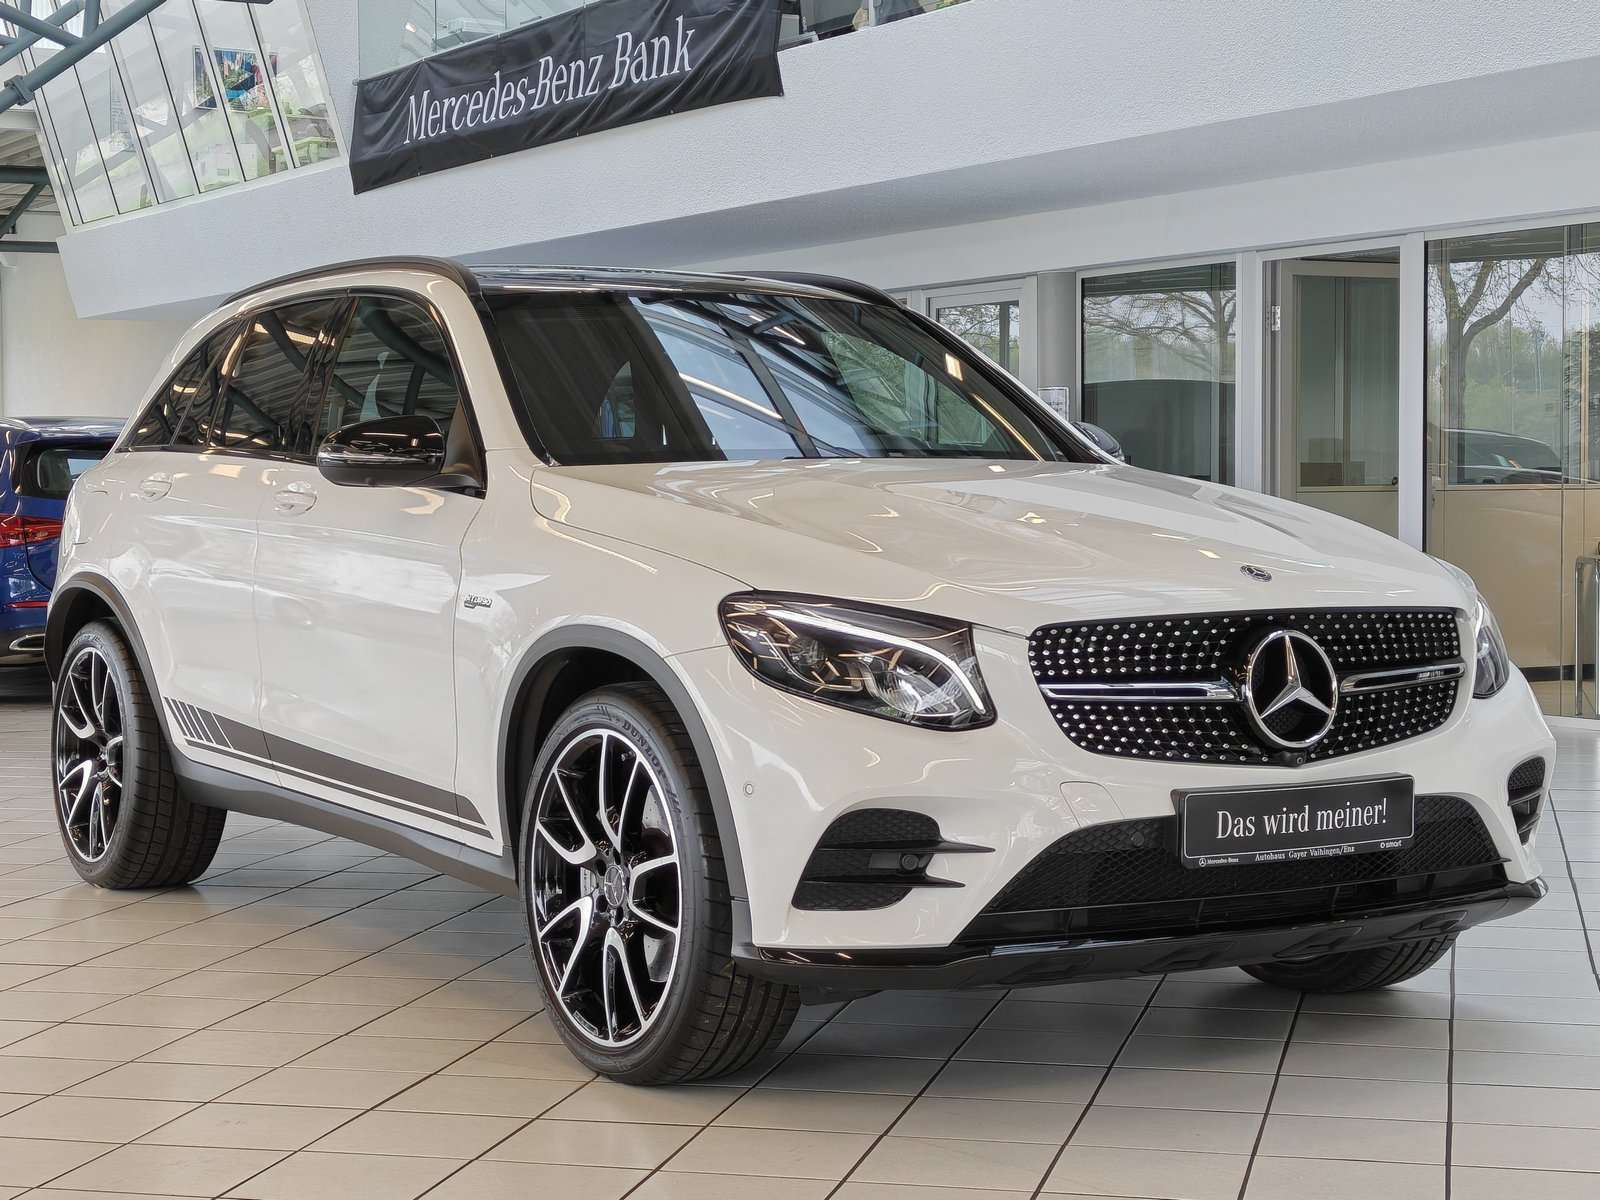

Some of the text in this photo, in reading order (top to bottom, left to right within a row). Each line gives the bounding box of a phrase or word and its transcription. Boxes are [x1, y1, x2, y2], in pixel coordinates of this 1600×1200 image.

[403, 15, 696, 145] Mercedes-Benz Bank
[621, 719, 667, 779] DUNLOP
[1216, 797, 1387, 839] Das wird meiner!
[1255, 845, 1356, 862] Autohaus Gayer Vaihingen/Enz
